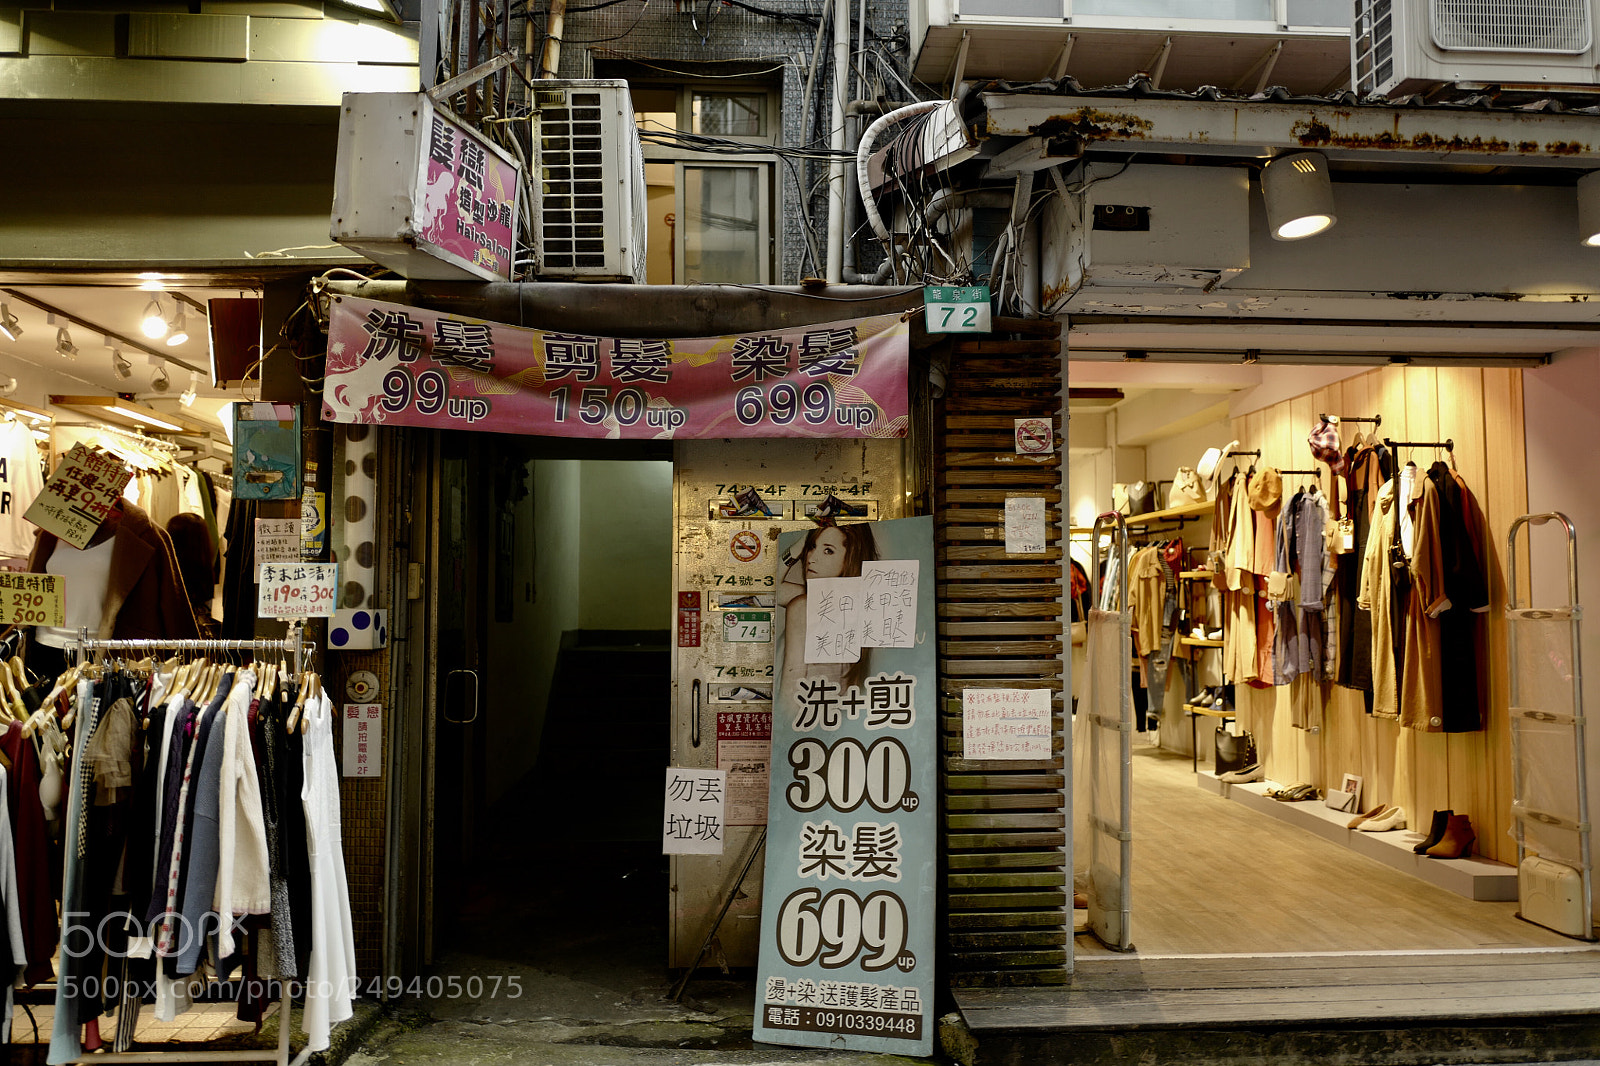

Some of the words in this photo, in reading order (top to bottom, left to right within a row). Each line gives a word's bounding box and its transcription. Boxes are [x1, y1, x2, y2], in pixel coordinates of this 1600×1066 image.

[932, 288, 982, 301] 龍泉街
[940, 306, 978, 328] 72
[361, 308, 495, 373] 洗髮
[540, 331, 674, 384] 剪髮
[731, 325, 861, 383] 染髮
[12, 592, 43, 608] 290
[273, 584, 301, 603] 190
[12, 607, 46, 623] 500
[741, 625, 757, 638] 74
[357, 766, 368, 775] 2F
[666, 813, 721, 841] 垃圾
[800, 823, 900, 879] 染髮
